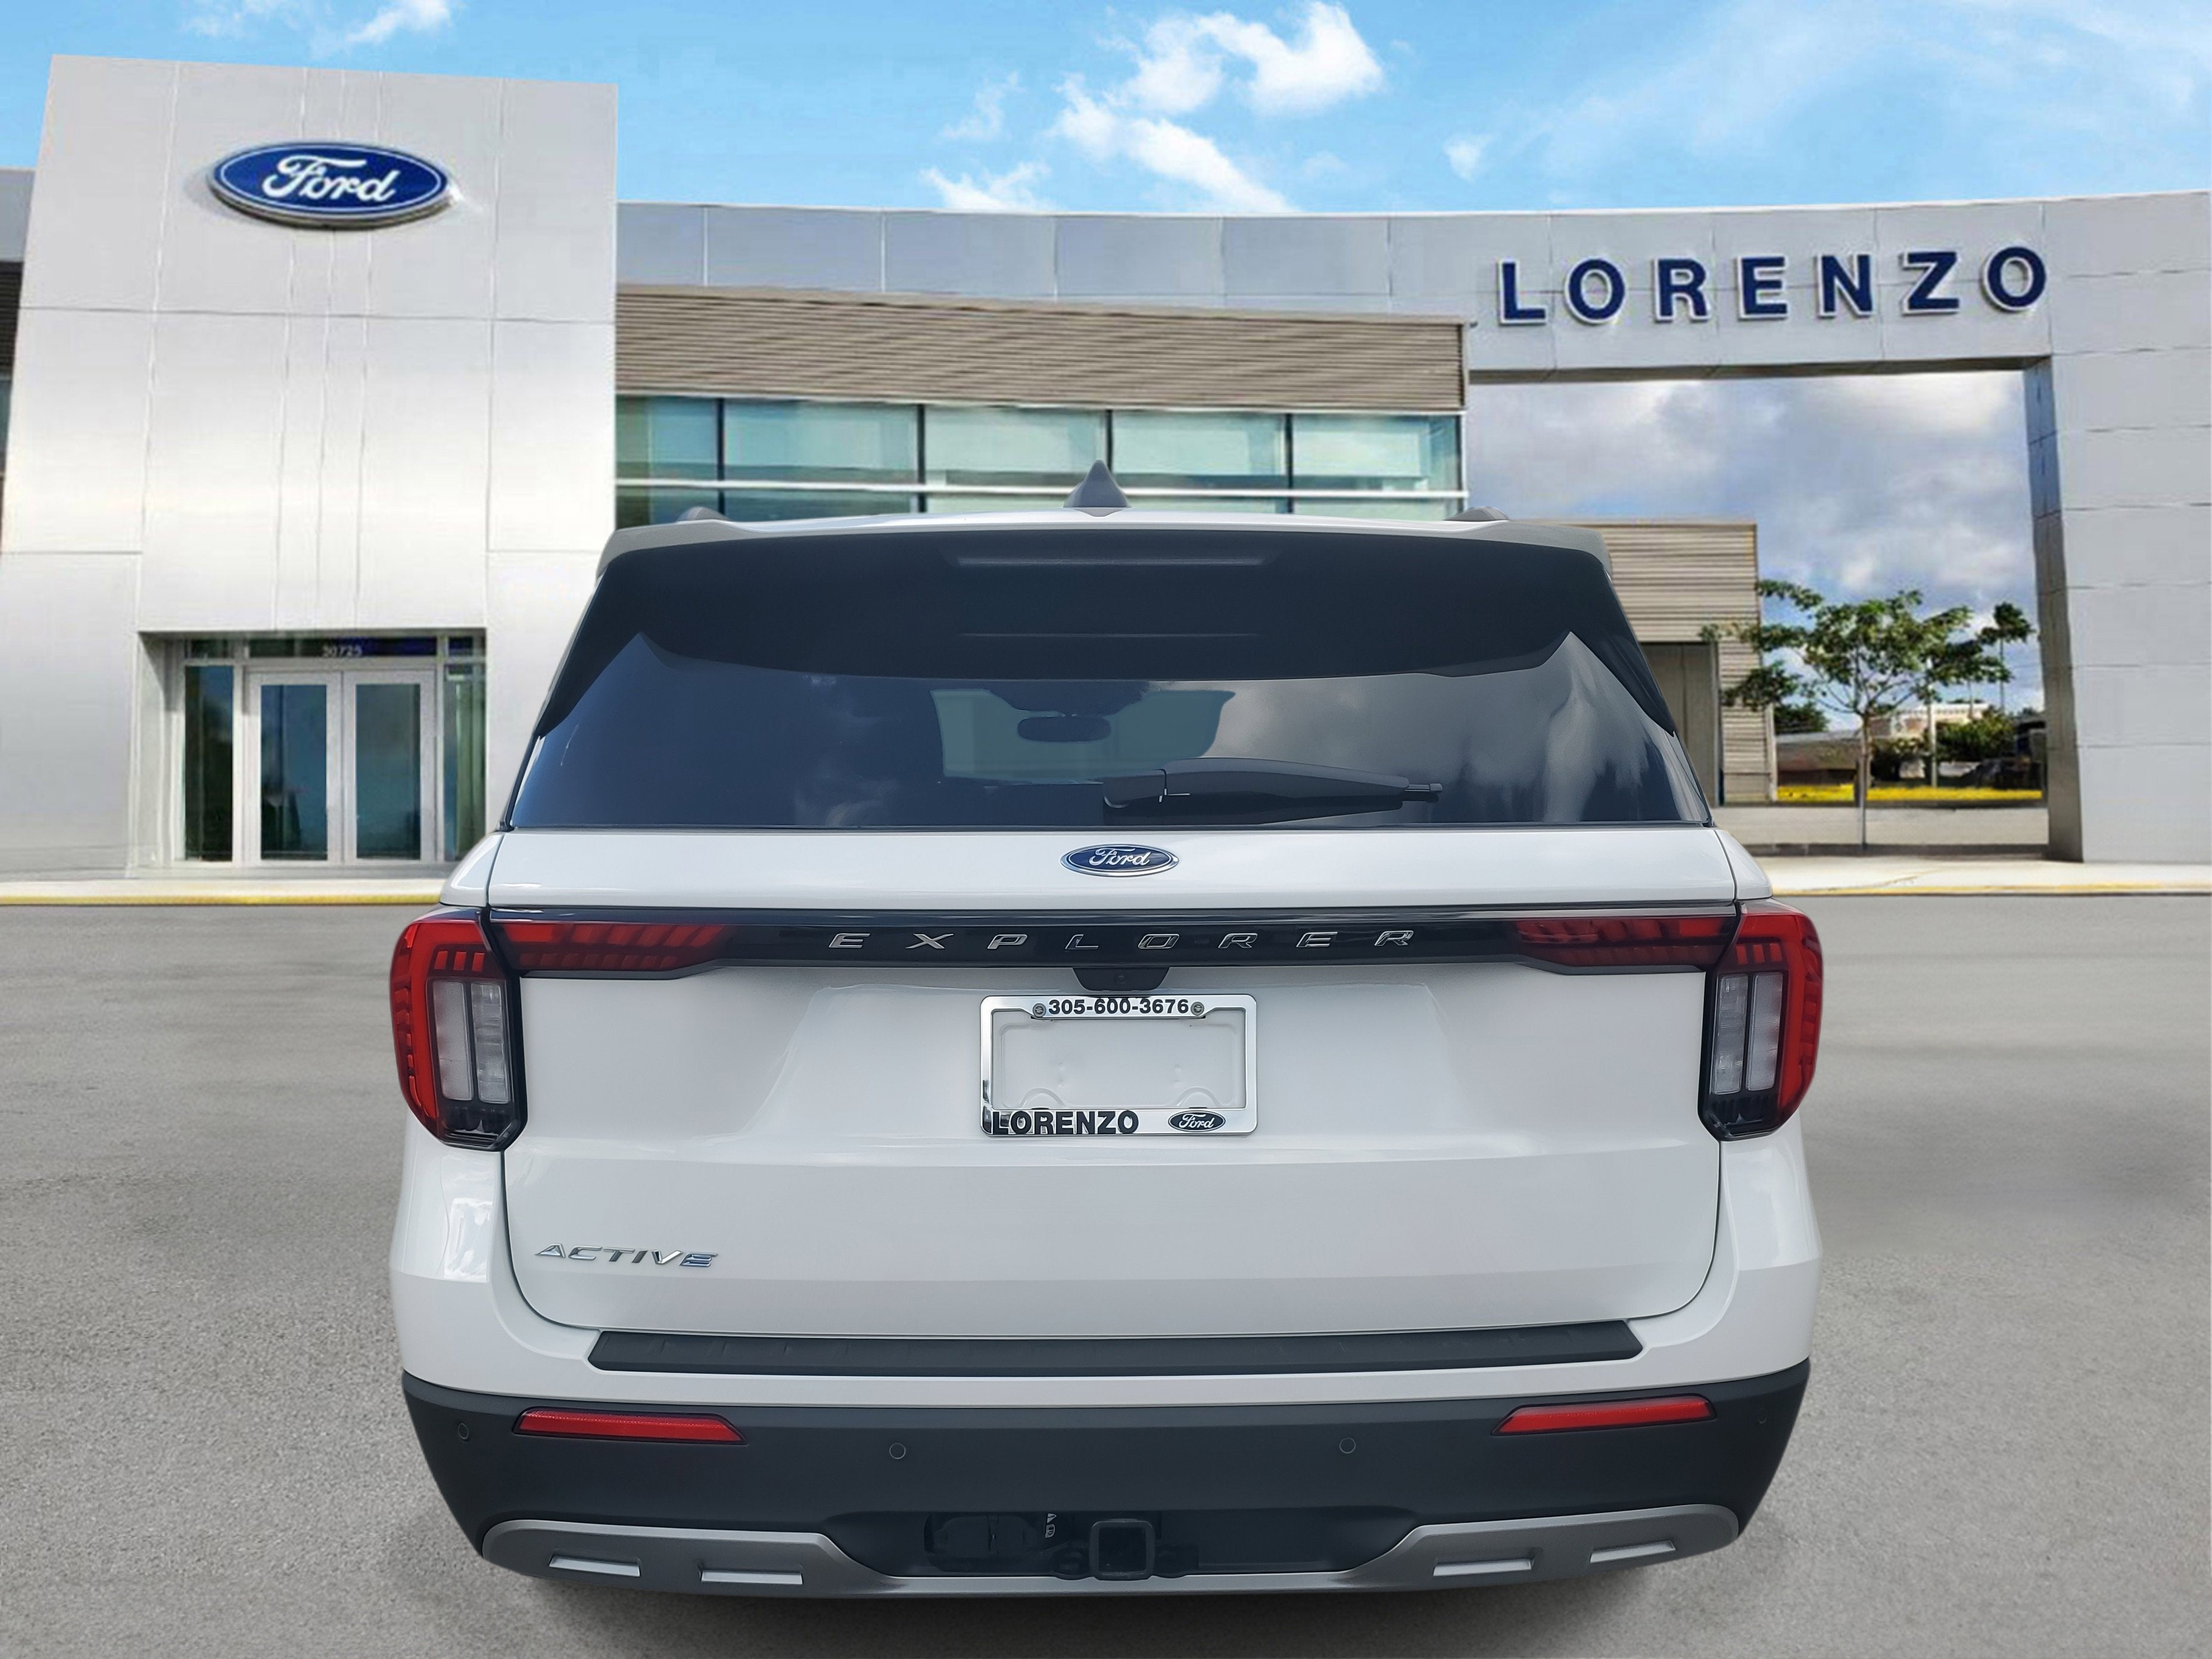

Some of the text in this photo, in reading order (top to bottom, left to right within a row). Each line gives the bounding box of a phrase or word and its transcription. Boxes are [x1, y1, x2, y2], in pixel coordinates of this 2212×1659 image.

[261, 154, 400, 202] Ford
[1497, 246, 2047, 325] LORENZO
[1089, 847, 1151, 866] Ford
[828, 930, 1415, 950] EXPLORER
[1048, 998, 1189, 1014] 305-600-3676
[992, 1110, 1139, 1135] LORENZO
[1178, 1113, 1216, 1129] Ford
[534, 1243, 718, 1267] ACTIVE
